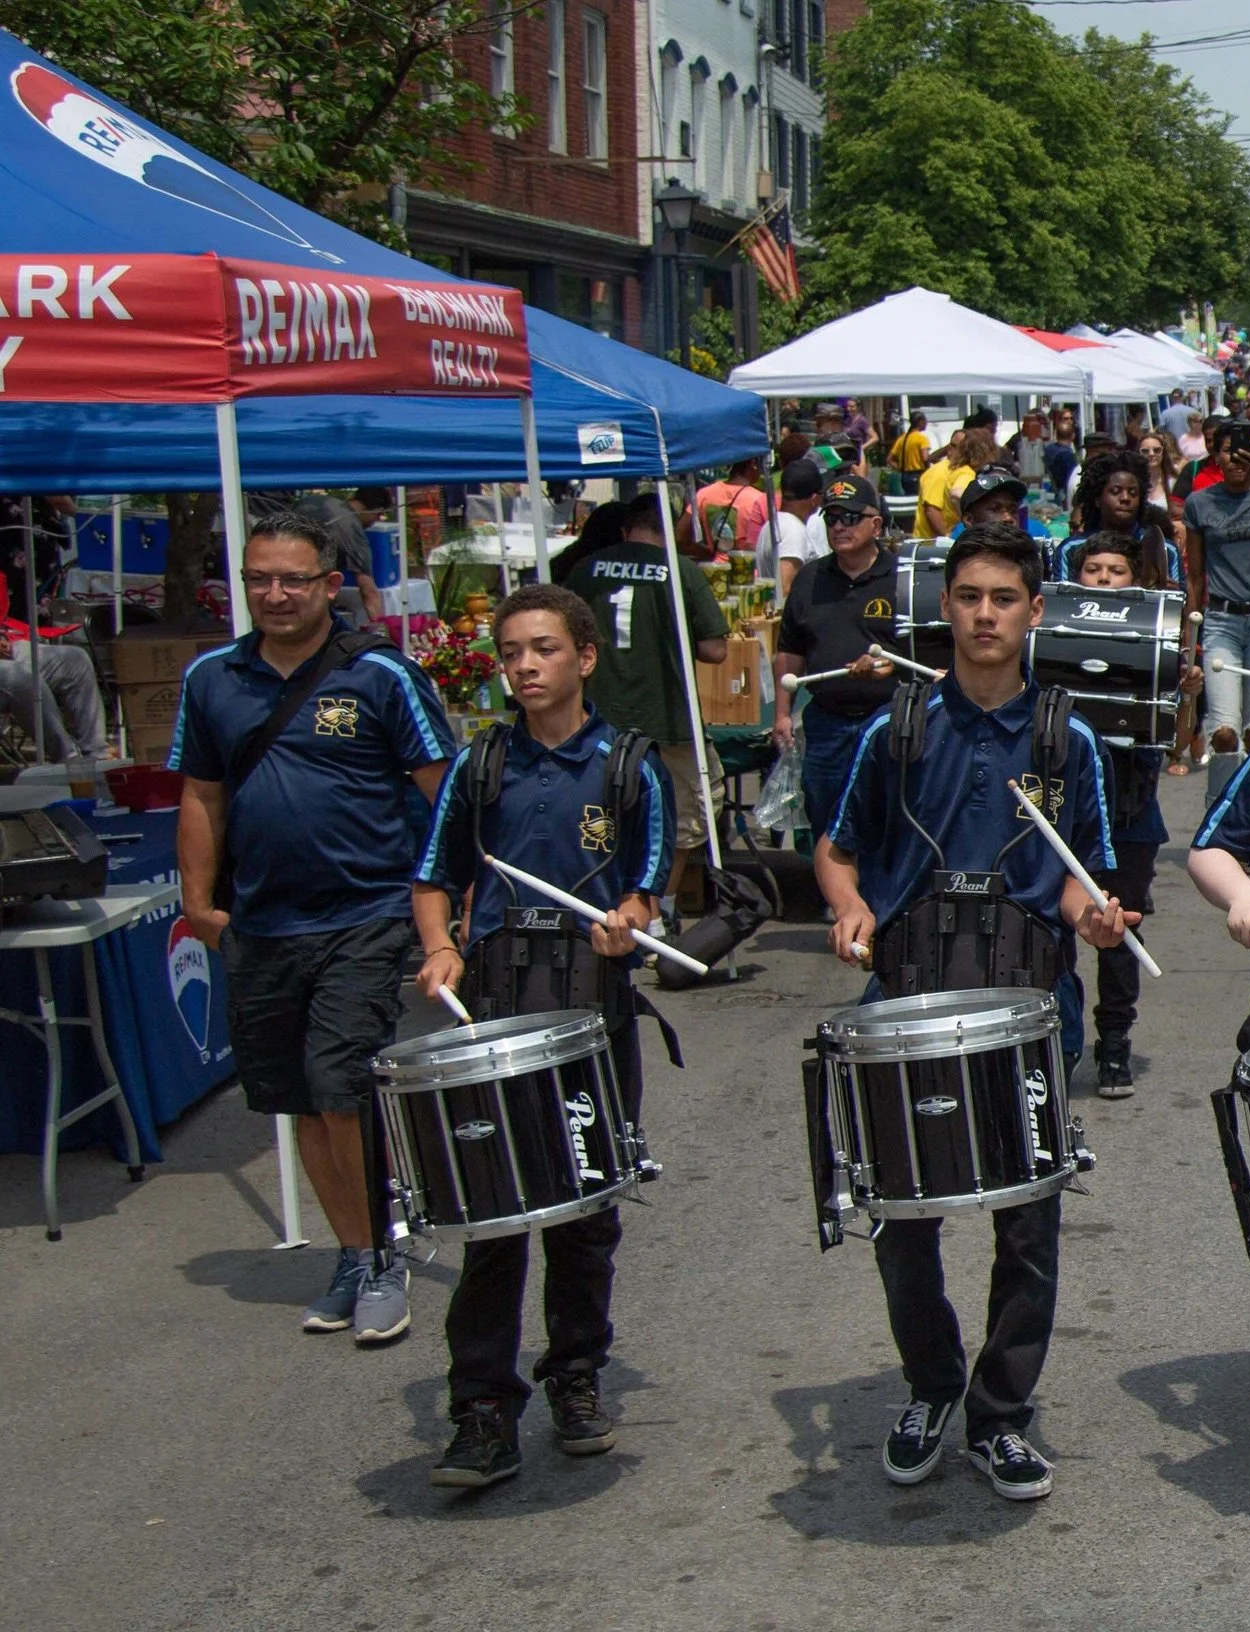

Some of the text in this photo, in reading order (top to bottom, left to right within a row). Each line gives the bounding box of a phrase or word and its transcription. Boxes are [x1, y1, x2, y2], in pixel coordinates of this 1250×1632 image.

[0, 264, 134, 321] RK
[385, 284, 515, 338] BENCHMARK
[235, 277, 378, 366] RE/MAX
[430, 338, 500, 389] REALTY
[592, 561, 670, 582] PICKLES
[609, 585, 635, 649] 1
[1070, 601, 1131, 623] Pearl
[944, 872, 992, 894] Pearl
[516, 908, 563, 930] Pearl
[174, 951, 205, 981] RE/MAX
[565, 1091, 605, 1181] Pearl
